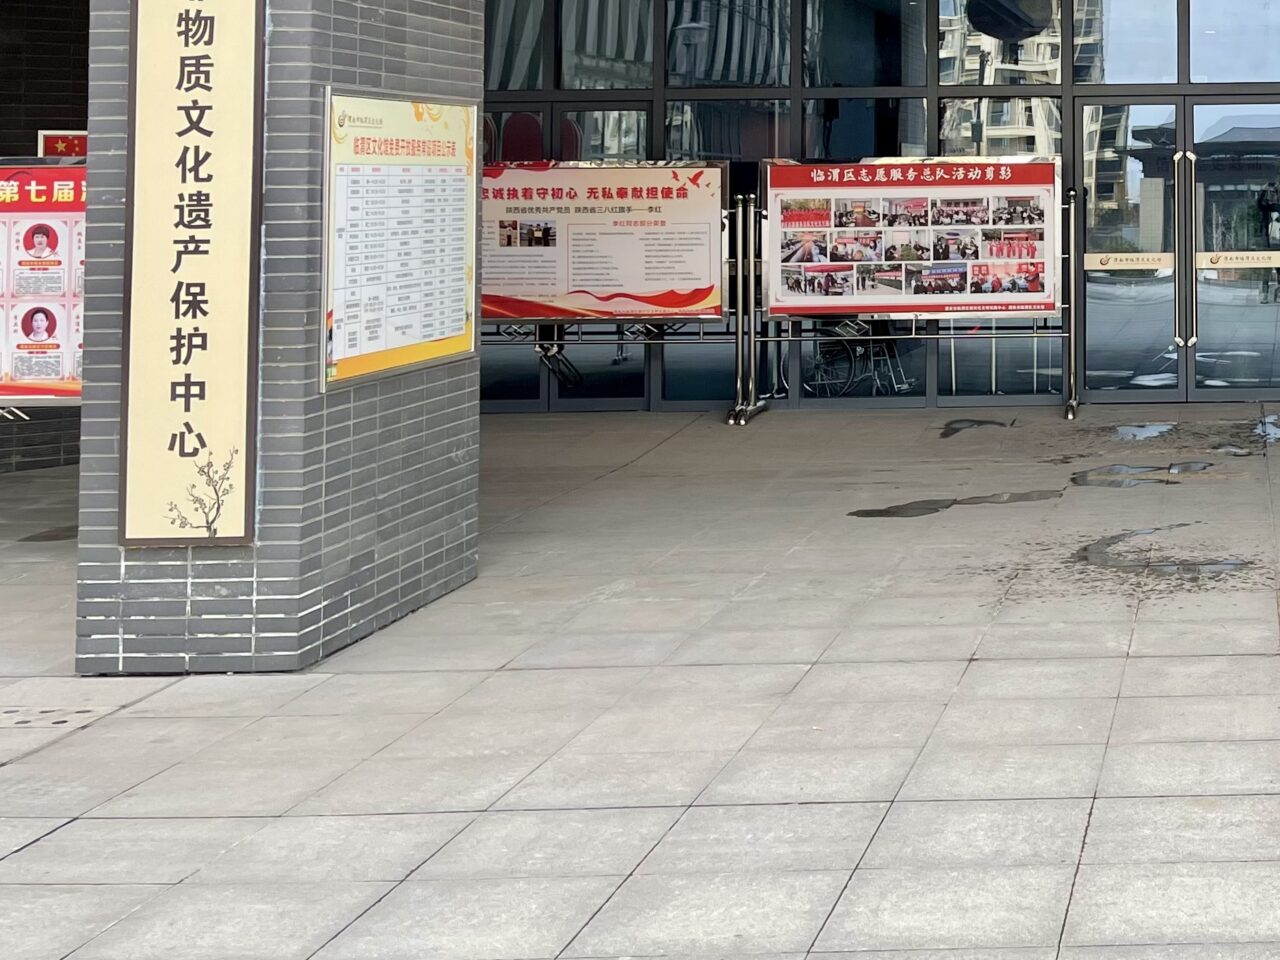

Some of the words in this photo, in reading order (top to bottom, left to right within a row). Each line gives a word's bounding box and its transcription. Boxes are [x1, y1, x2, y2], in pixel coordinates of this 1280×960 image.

[810, 166, 1012, 183] 临渭区志愿服务总队活动剪影
[0, 180, 86, 203] 第七届
[586, 186, 689, 200] 无私奉献担使命
